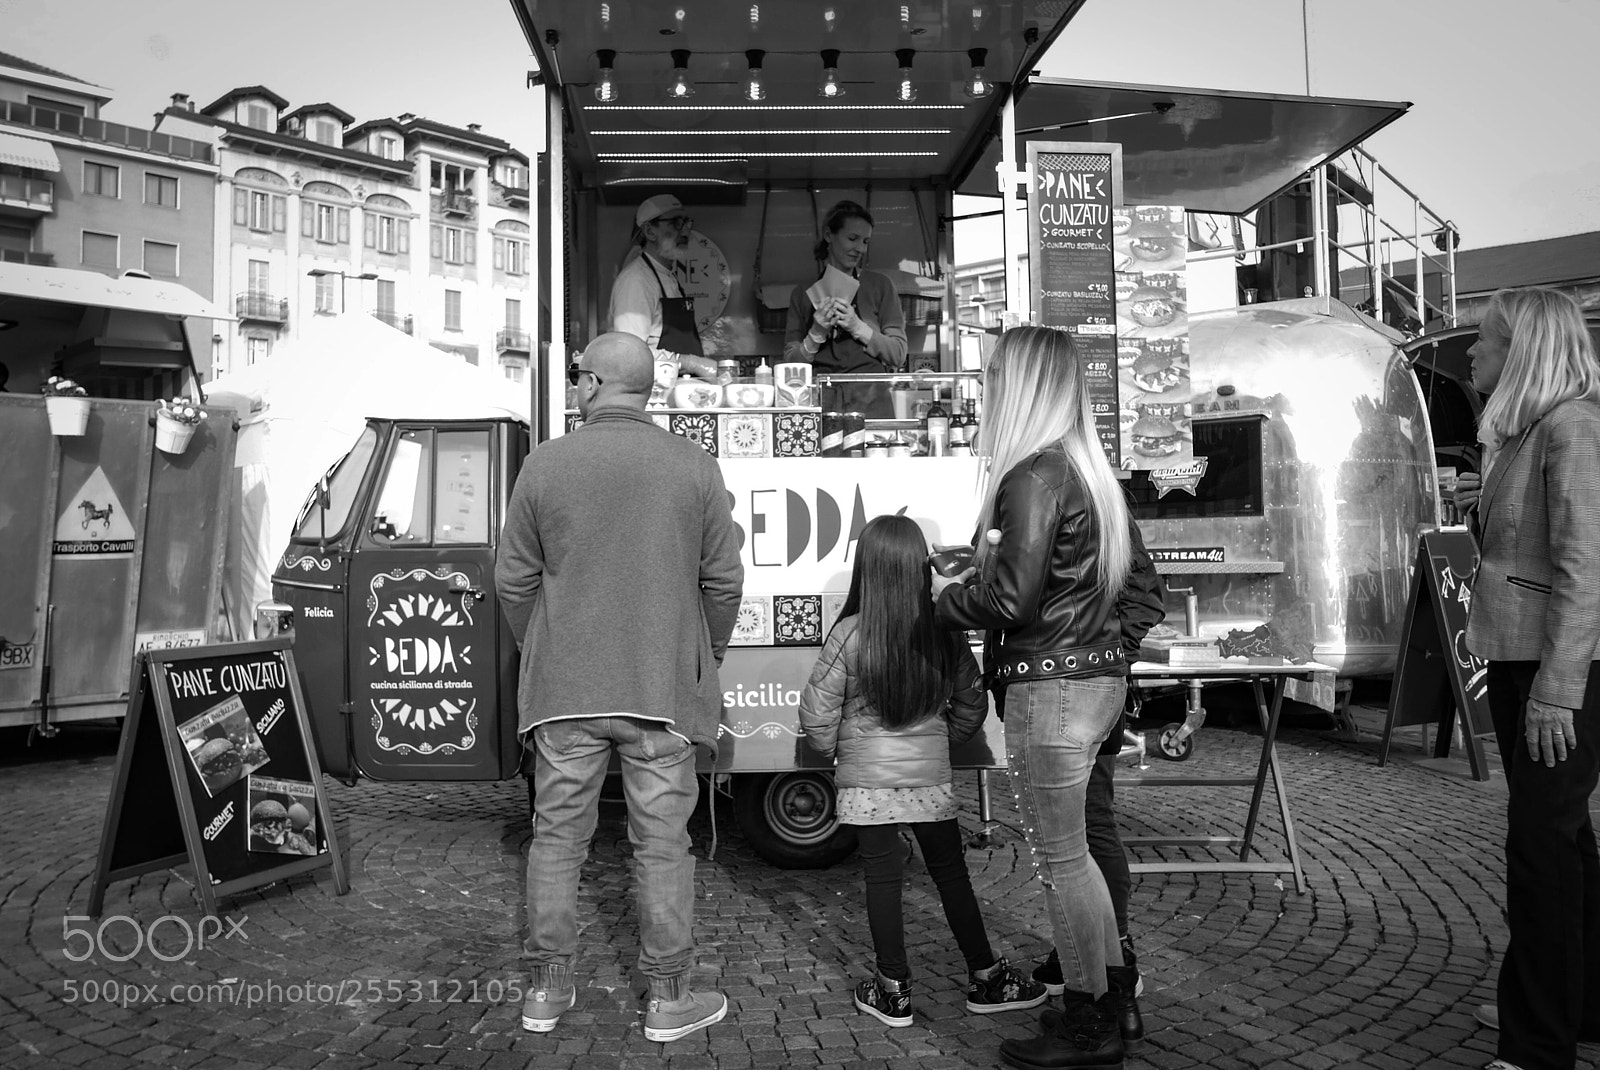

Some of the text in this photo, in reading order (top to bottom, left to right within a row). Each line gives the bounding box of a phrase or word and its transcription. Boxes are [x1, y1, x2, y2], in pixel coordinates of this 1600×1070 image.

[1045, 171, 1096, 200] PANE
[1039, 203, 1109, 225] CUNZATU
[1051, 228, 1094, 238] GOURMET
[1076, 242, 1106, 250] SCOPELLO
[675, 259, 700, 284] NE
[1194, 400, 1240, 413] EAM
[53, 541, 134, 554] Trasporto Cavalli
[304, 607, 334, 618] Felicia
[0, 647, 32, 665] 9BX
[384, 635, 458, 676] BEDDA
[170, 661, 286, 699] PANE CUNZATU
[370, 680, 473, 690] cucina siciliana di strada
[256, 698, 285, 734] SICILIANO
[203, 801, 235, 840] GOURMET
